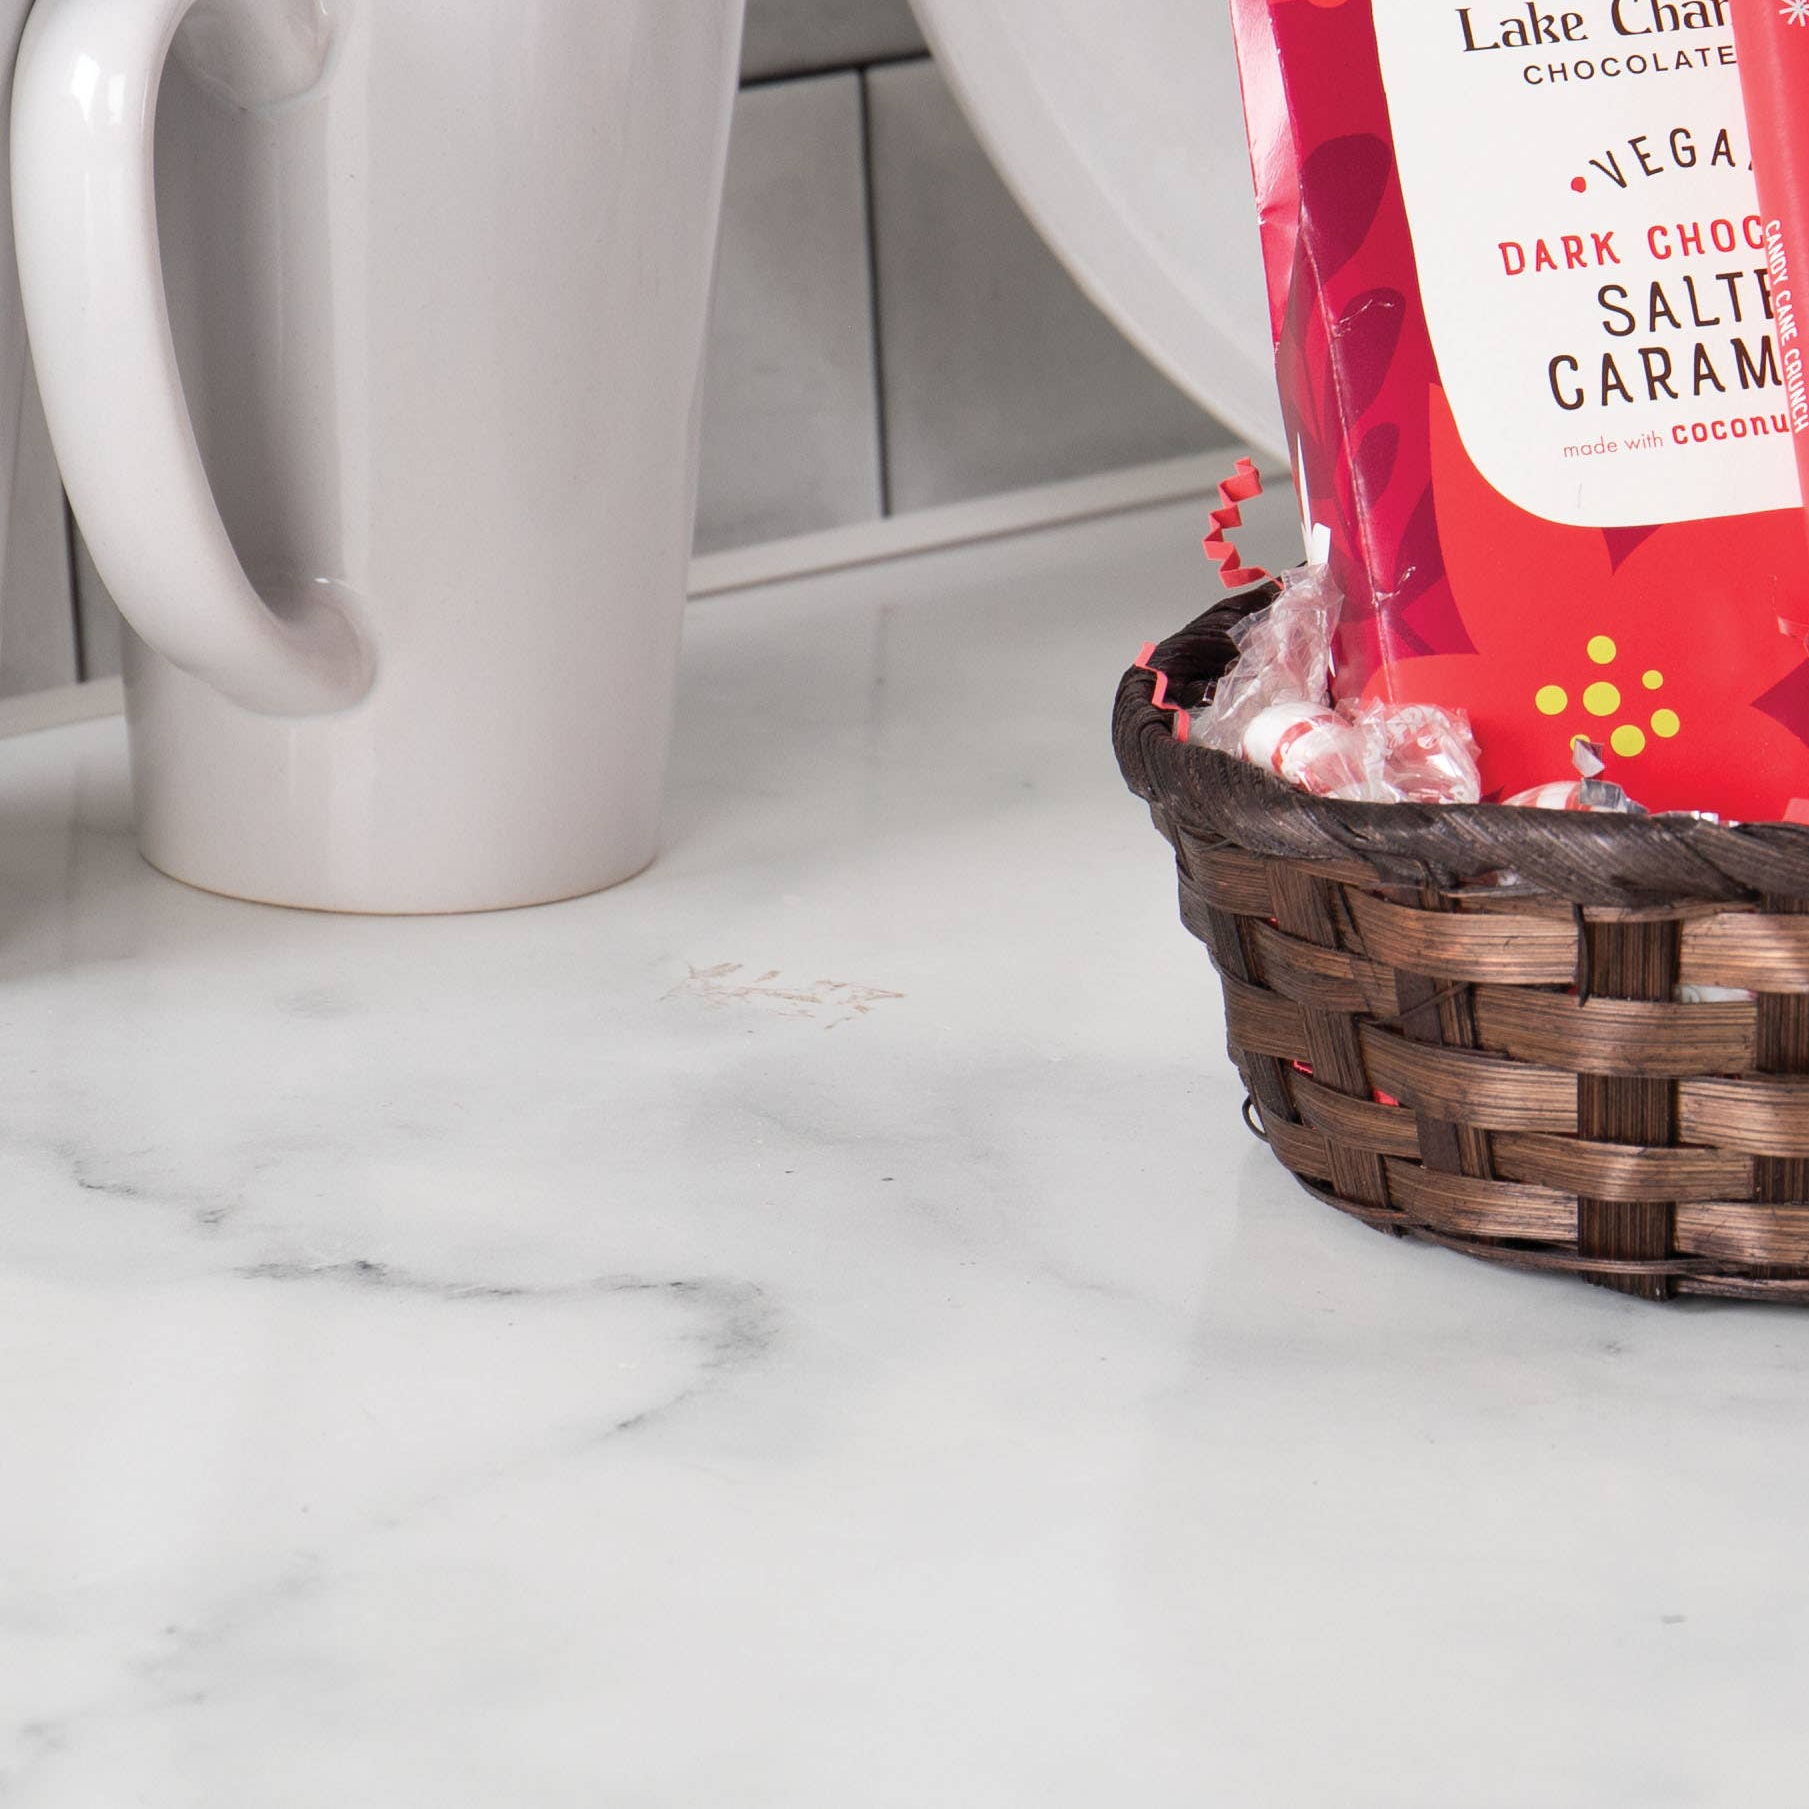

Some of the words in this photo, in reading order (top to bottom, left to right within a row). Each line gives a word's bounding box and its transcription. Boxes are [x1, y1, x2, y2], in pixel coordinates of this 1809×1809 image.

[1455, 1, 1588, 52] Lake
[1523, 45, 1737, 85] CHOCOLATE
[1589, 127, 1752, 188] VEGA
[1498, 231, 1620, 276] DARK
[1647, 215, 1764, 260] CHOC
[1765, 219, 1788, 285] CANDY
[1775, 290, 1797, 346] CANE
[1548, 335, 1782, 411] CARAM
[1784, 348, 1809, 434] CRUNCH
[1563, 436, 1618, 458] made
[1624, 430, 1664, 451] with
[1672, 413, 1789, 444] coconu
